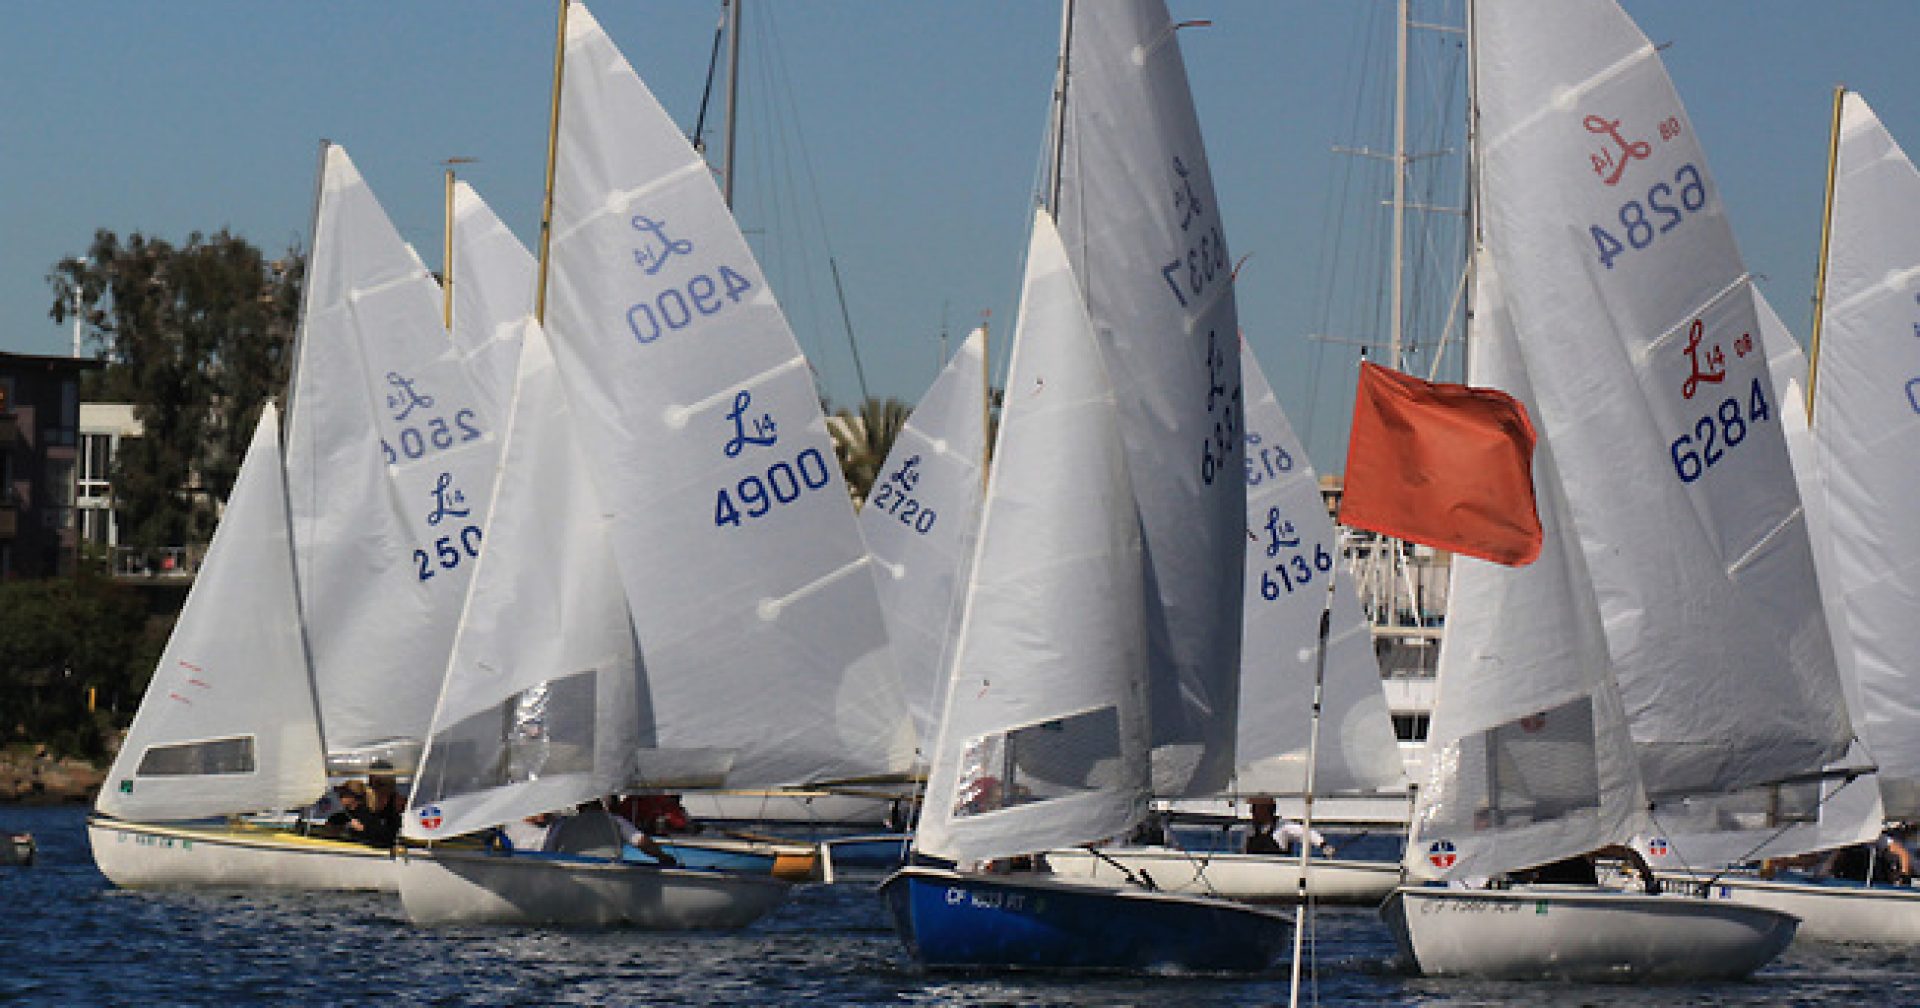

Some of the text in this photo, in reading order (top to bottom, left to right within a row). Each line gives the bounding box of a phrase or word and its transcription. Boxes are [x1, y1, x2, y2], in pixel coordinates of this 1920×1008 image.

[1671, 377, 1770, 483] 6284
[715, 448, 829, 527] 4900
[874, 482, 937, 535] 2720
[1261, 543, 1333, 601] 6136
